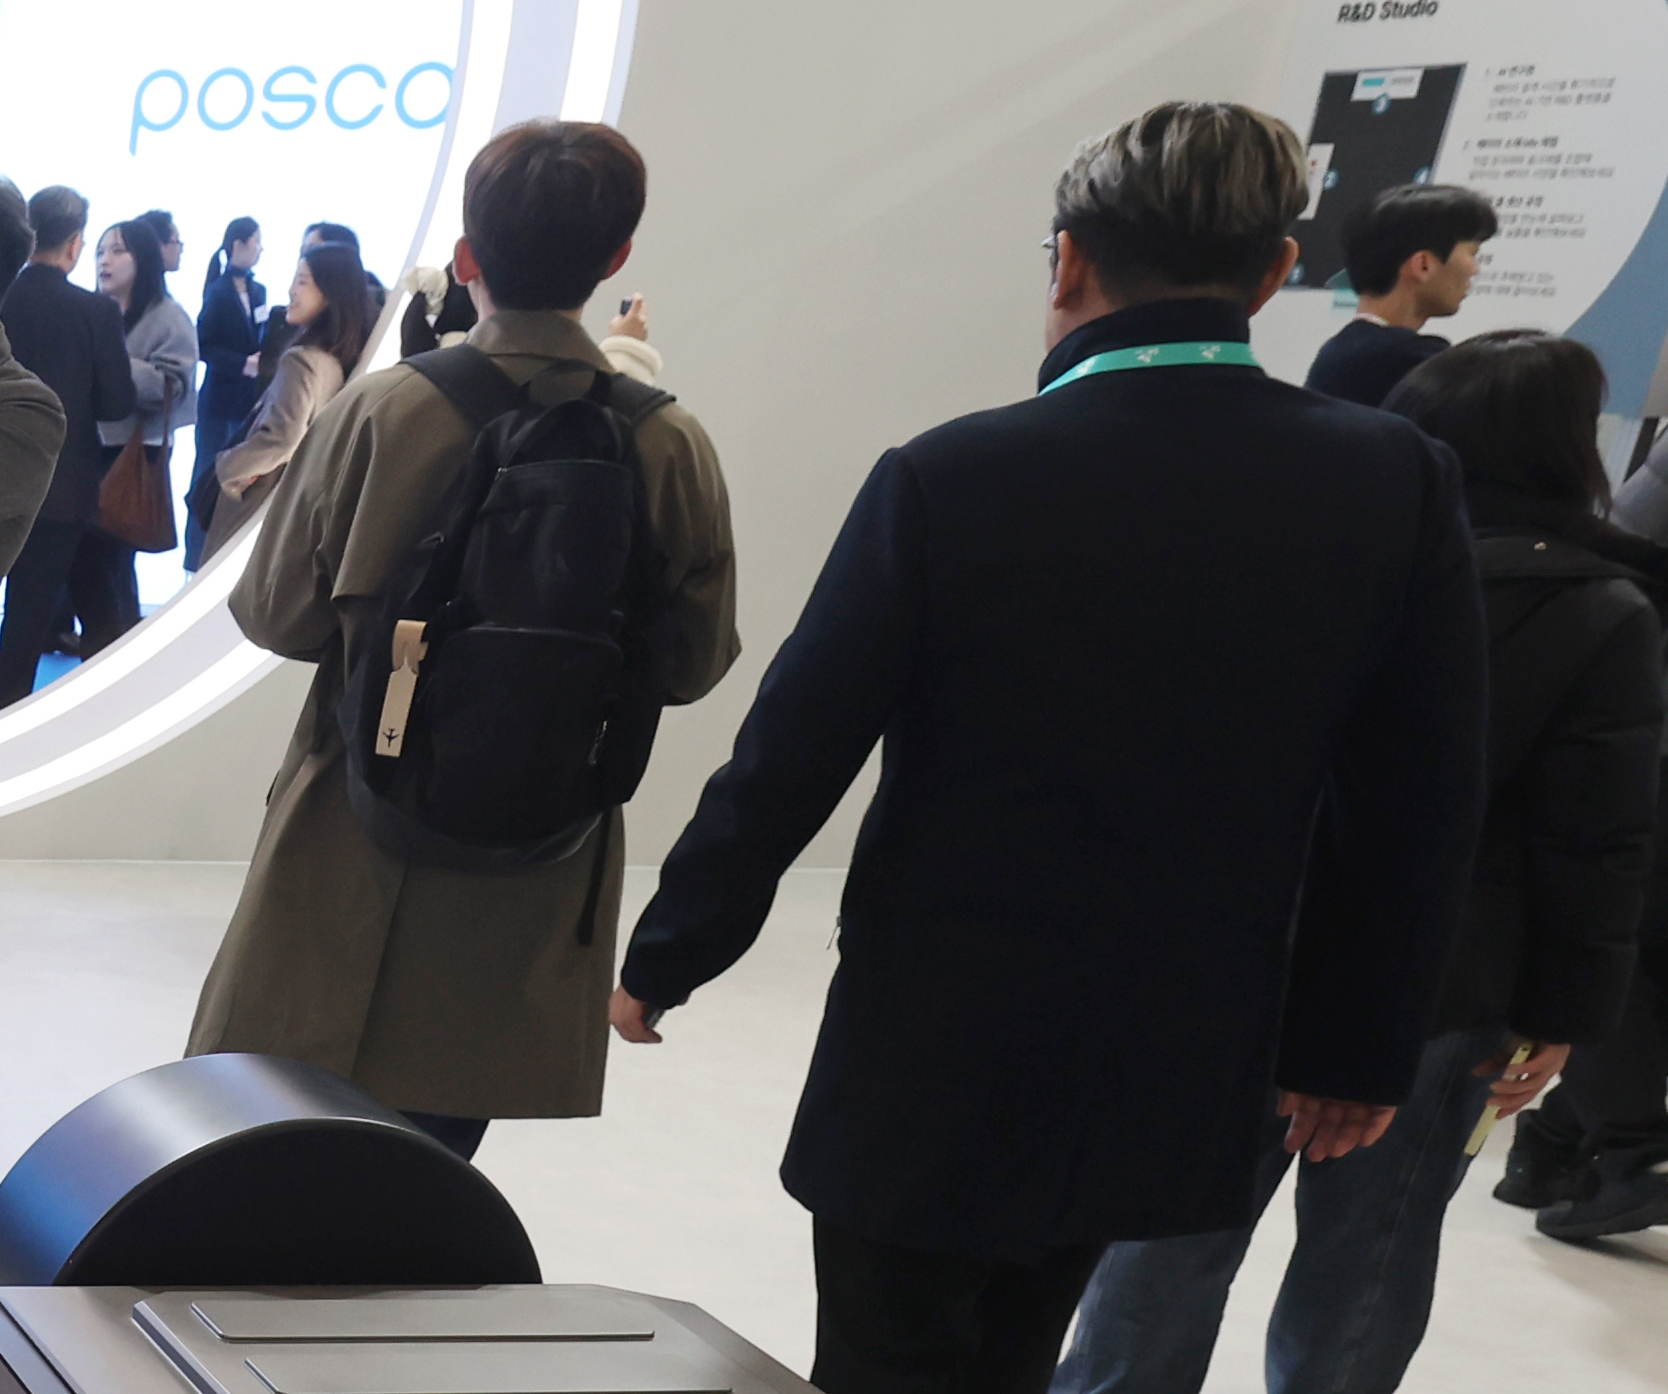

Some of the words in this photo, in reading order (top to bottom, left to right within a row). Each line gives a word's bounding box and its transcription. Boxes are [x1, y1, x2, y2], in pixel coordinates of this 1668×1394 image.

[1336, 2, 1376, 23] R&D
[1379, 0, 1439, 20] Studio
[129, 61, 457, 156] posco
